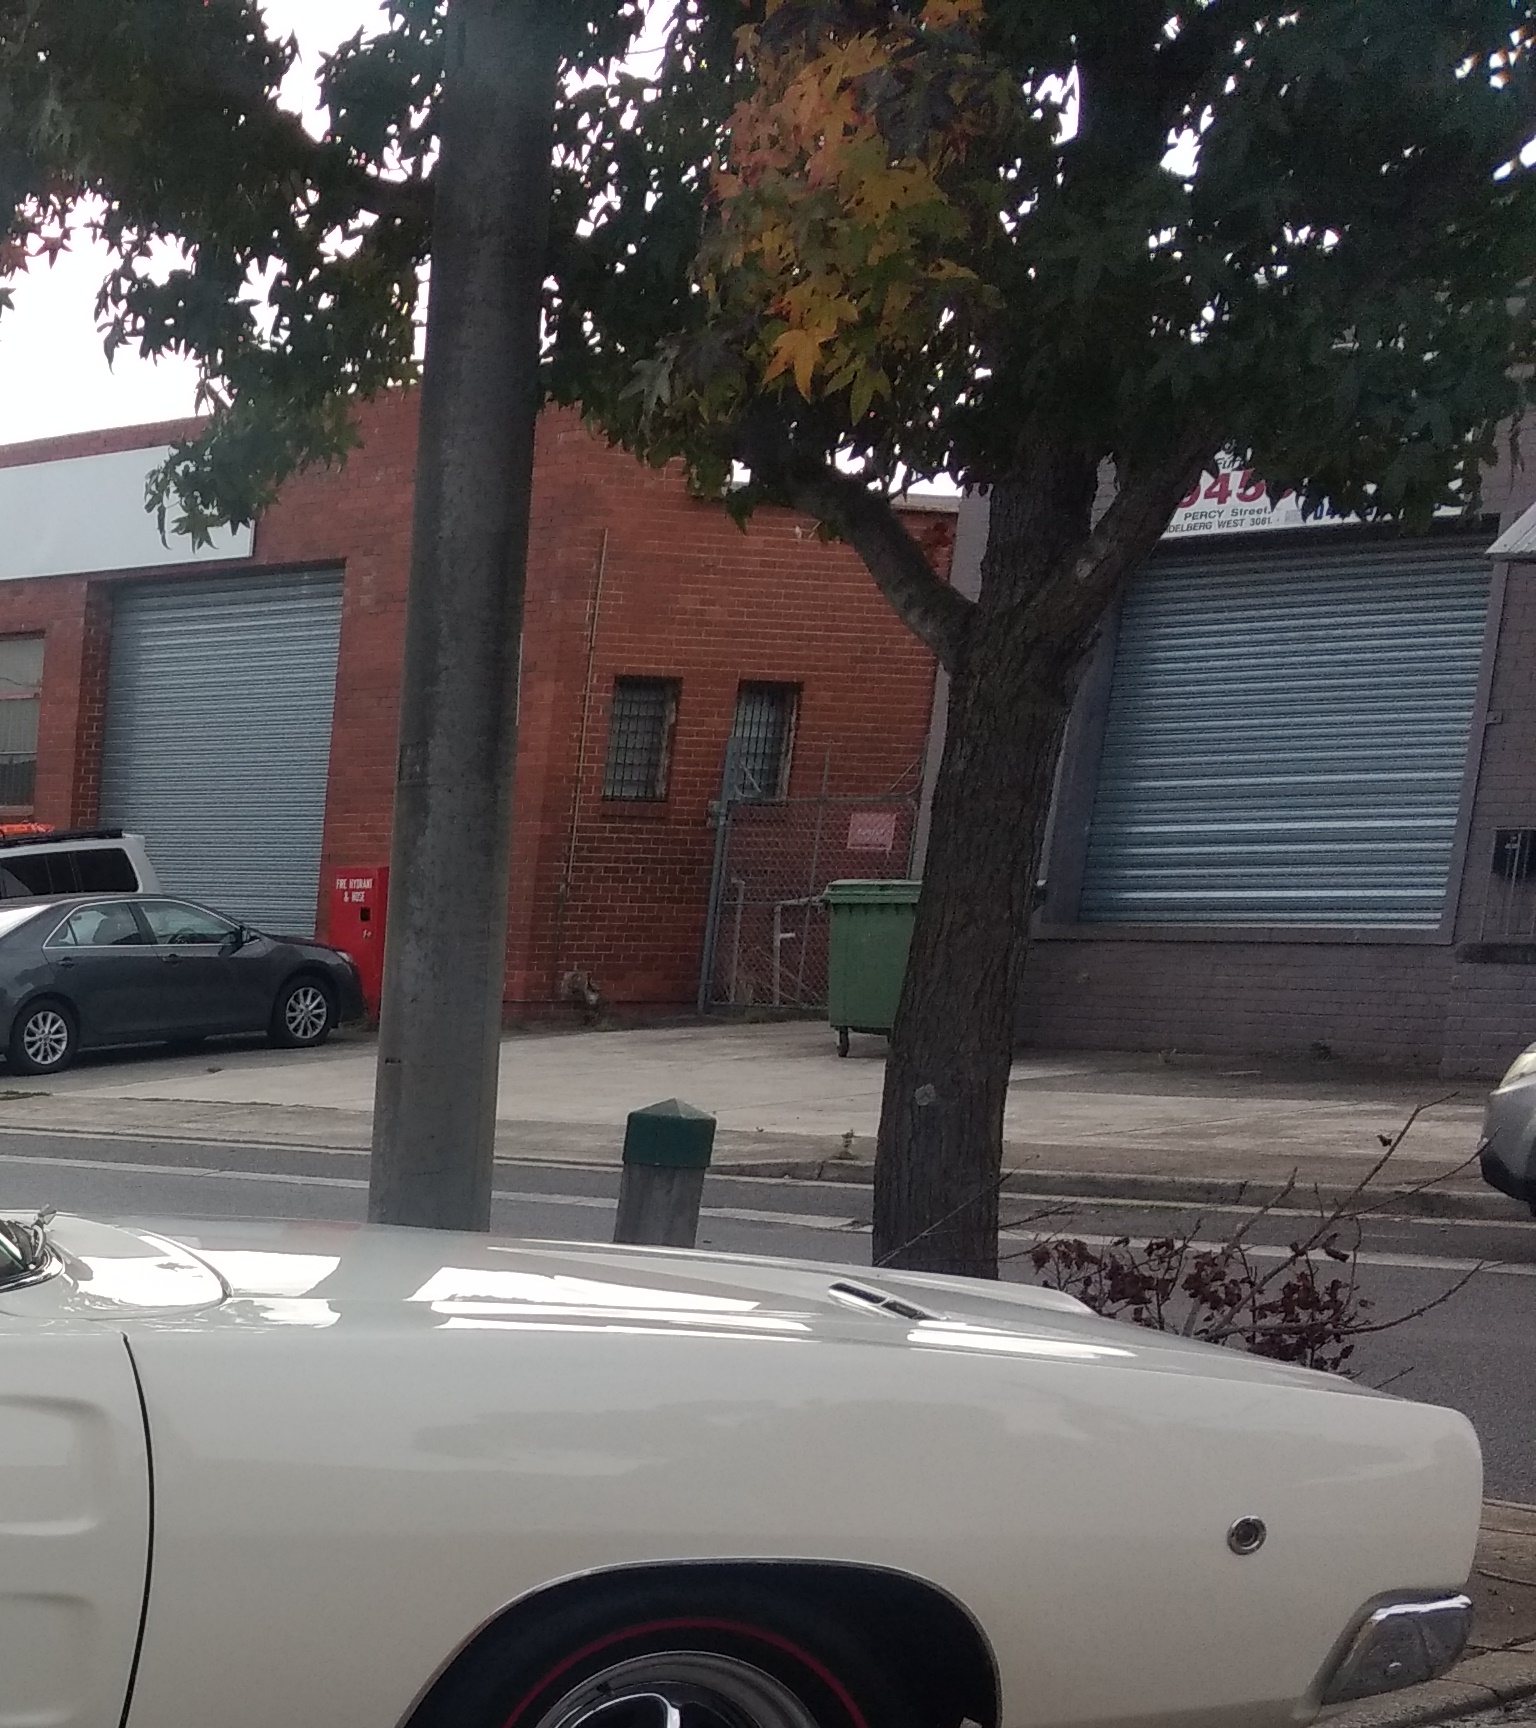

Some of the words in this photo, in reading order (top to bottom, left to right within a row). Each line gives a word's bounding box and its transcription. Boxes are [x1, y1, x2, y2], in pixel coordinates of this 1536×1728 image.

[1183, 509, 1225, 522] PERCY
[1166, 521, 1213, 534] DELBERG
[1217, 518, 1246, 529] WEST
